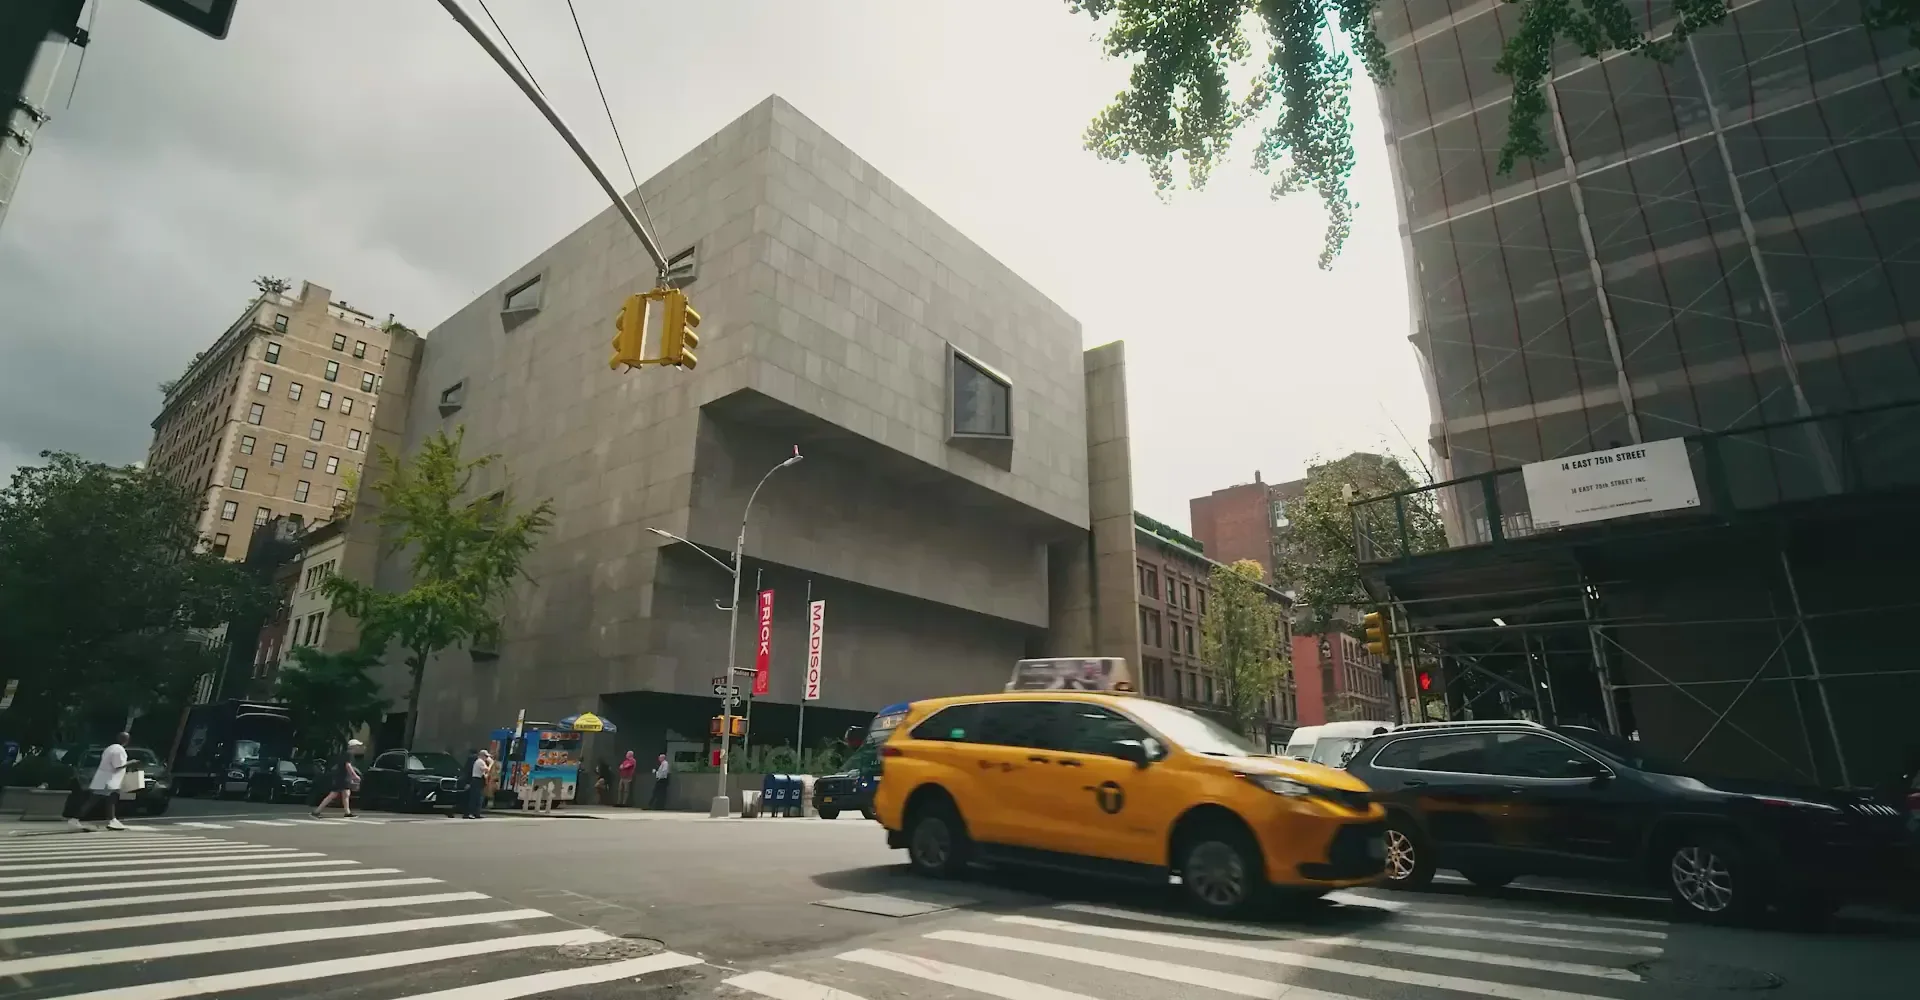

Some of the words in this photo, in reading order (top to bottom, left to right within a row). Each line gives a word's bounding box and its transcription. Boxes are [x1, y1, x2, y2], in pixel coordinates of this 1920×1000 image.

[1561, 463, 1570, 471] 14
[1572, 459, 1592, 469] EAST
[1594, 455, 1613, 465] 75th
[1616, 449, 1646, 462] STREET
[1578, 485, 1593, 493] EAST
[1610, 478, 1633, 487] STREET
[760, 592, 771, 656] FRICK
[808, 604, 822, 698] MADISON
